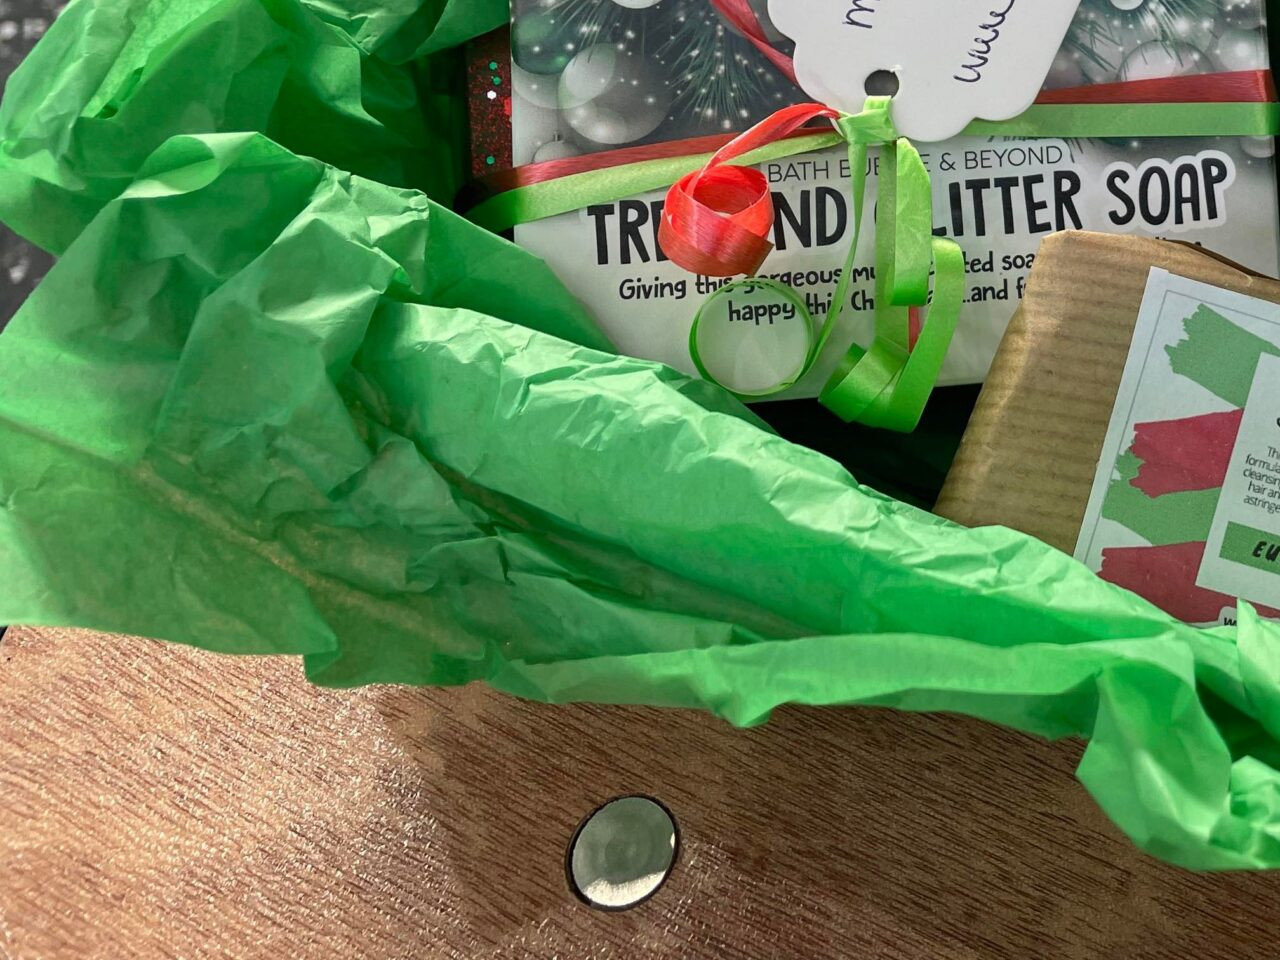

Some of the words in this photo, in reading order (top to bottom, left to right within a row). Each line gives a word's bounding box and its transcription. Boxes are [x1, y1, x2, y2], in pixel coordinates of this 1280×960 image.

[768, 159, 829, 183] BATH
[939, 152, 957, 172] &
[964, 145, 1063, 170] BEYOND
[874, 170, 1083, 237] ITTER
[1106, 157, 1228, 225] SOAP
[1002, 253, 1036, 271] soa
[619, 278, 687, 300] Giving
[728, 300, 795, 325] happy
[805, 292, 843, 315] thi
[1248, 480, 1268, 495] hair
